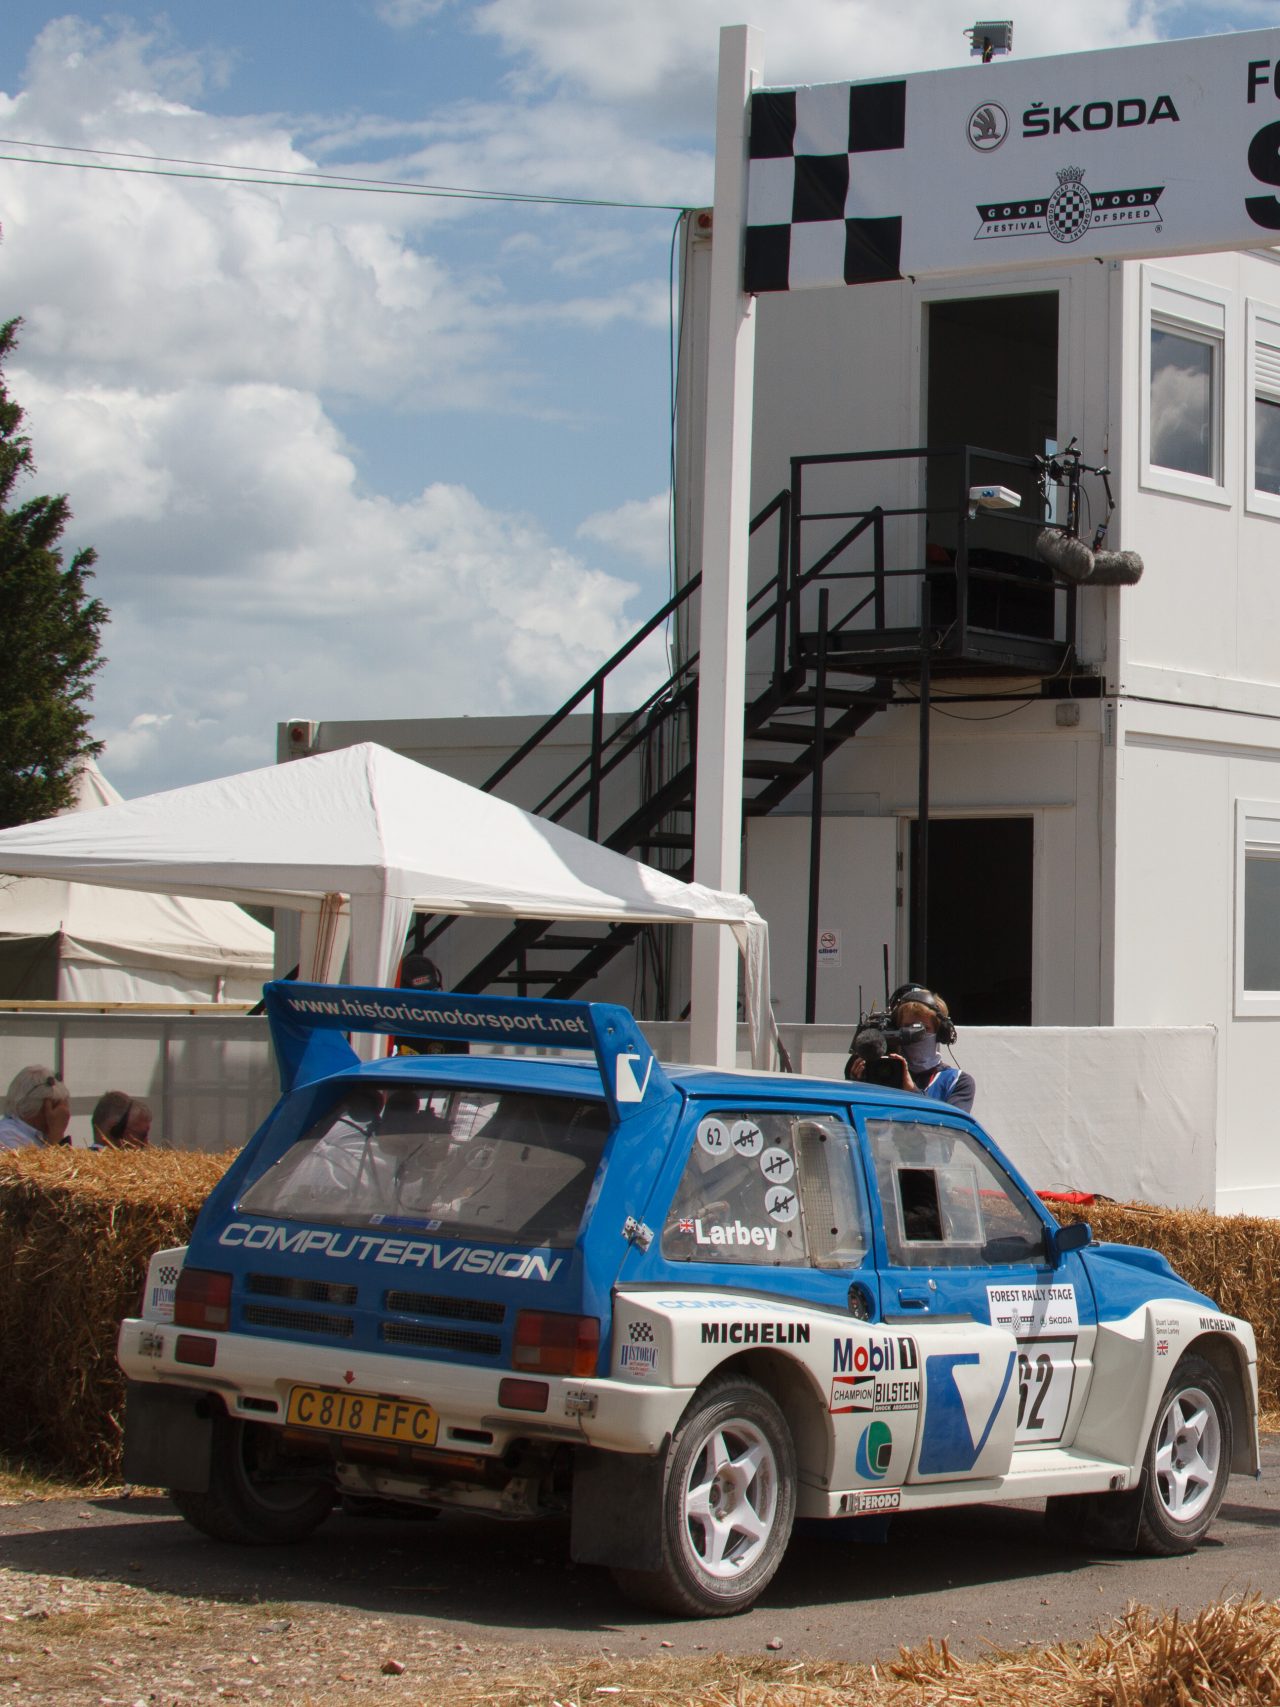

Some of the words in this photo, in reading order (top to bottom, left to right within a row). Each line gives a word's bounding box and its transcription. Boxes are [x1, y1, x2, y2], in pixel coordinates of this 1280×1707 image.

[1022, 95, 1181, 138] ŠKODA
[987, 204, 1042, 218] GOOD
[1095, 193, 1152, 207] WOOD
[986, 221, 1042, 233] FESTIVAL
[1094, 212, 1108, 222] OF
[1113, 210, 1150, 220] SPEED
[288, 998, 589, 1033] www.historicmotorsport.net
[707, 1128, 722, 1146] 62
[695, 1219, 777, 1251] Larbey
[218, 1222, 563, 1282] COMPUTERVISION
[990, 1290, 1019, 1302] FOREST
[1022, 1289, 1045, 1301] RALLY
[1049, 1288, 1072, 1300] STAGE
[1049, 1315, 1072, 1324] ŠKODA
[1200, 1318, 1236, 1331] MICHELIN
[701, 1322, 811, 1344] MICHELIN
[833, 1338, 894, 1372] Mobil
[899, 1338, 915, 1369] 1
[834, 1389, 873, 1401] CHAMPION
[875, 1382, 920, 1402] BILSTEIN
[298, 1392, 364, 1430] C818
[372, 1402, 431, 1440] FFC
[859, 1493, 900, 1510] FERODO
